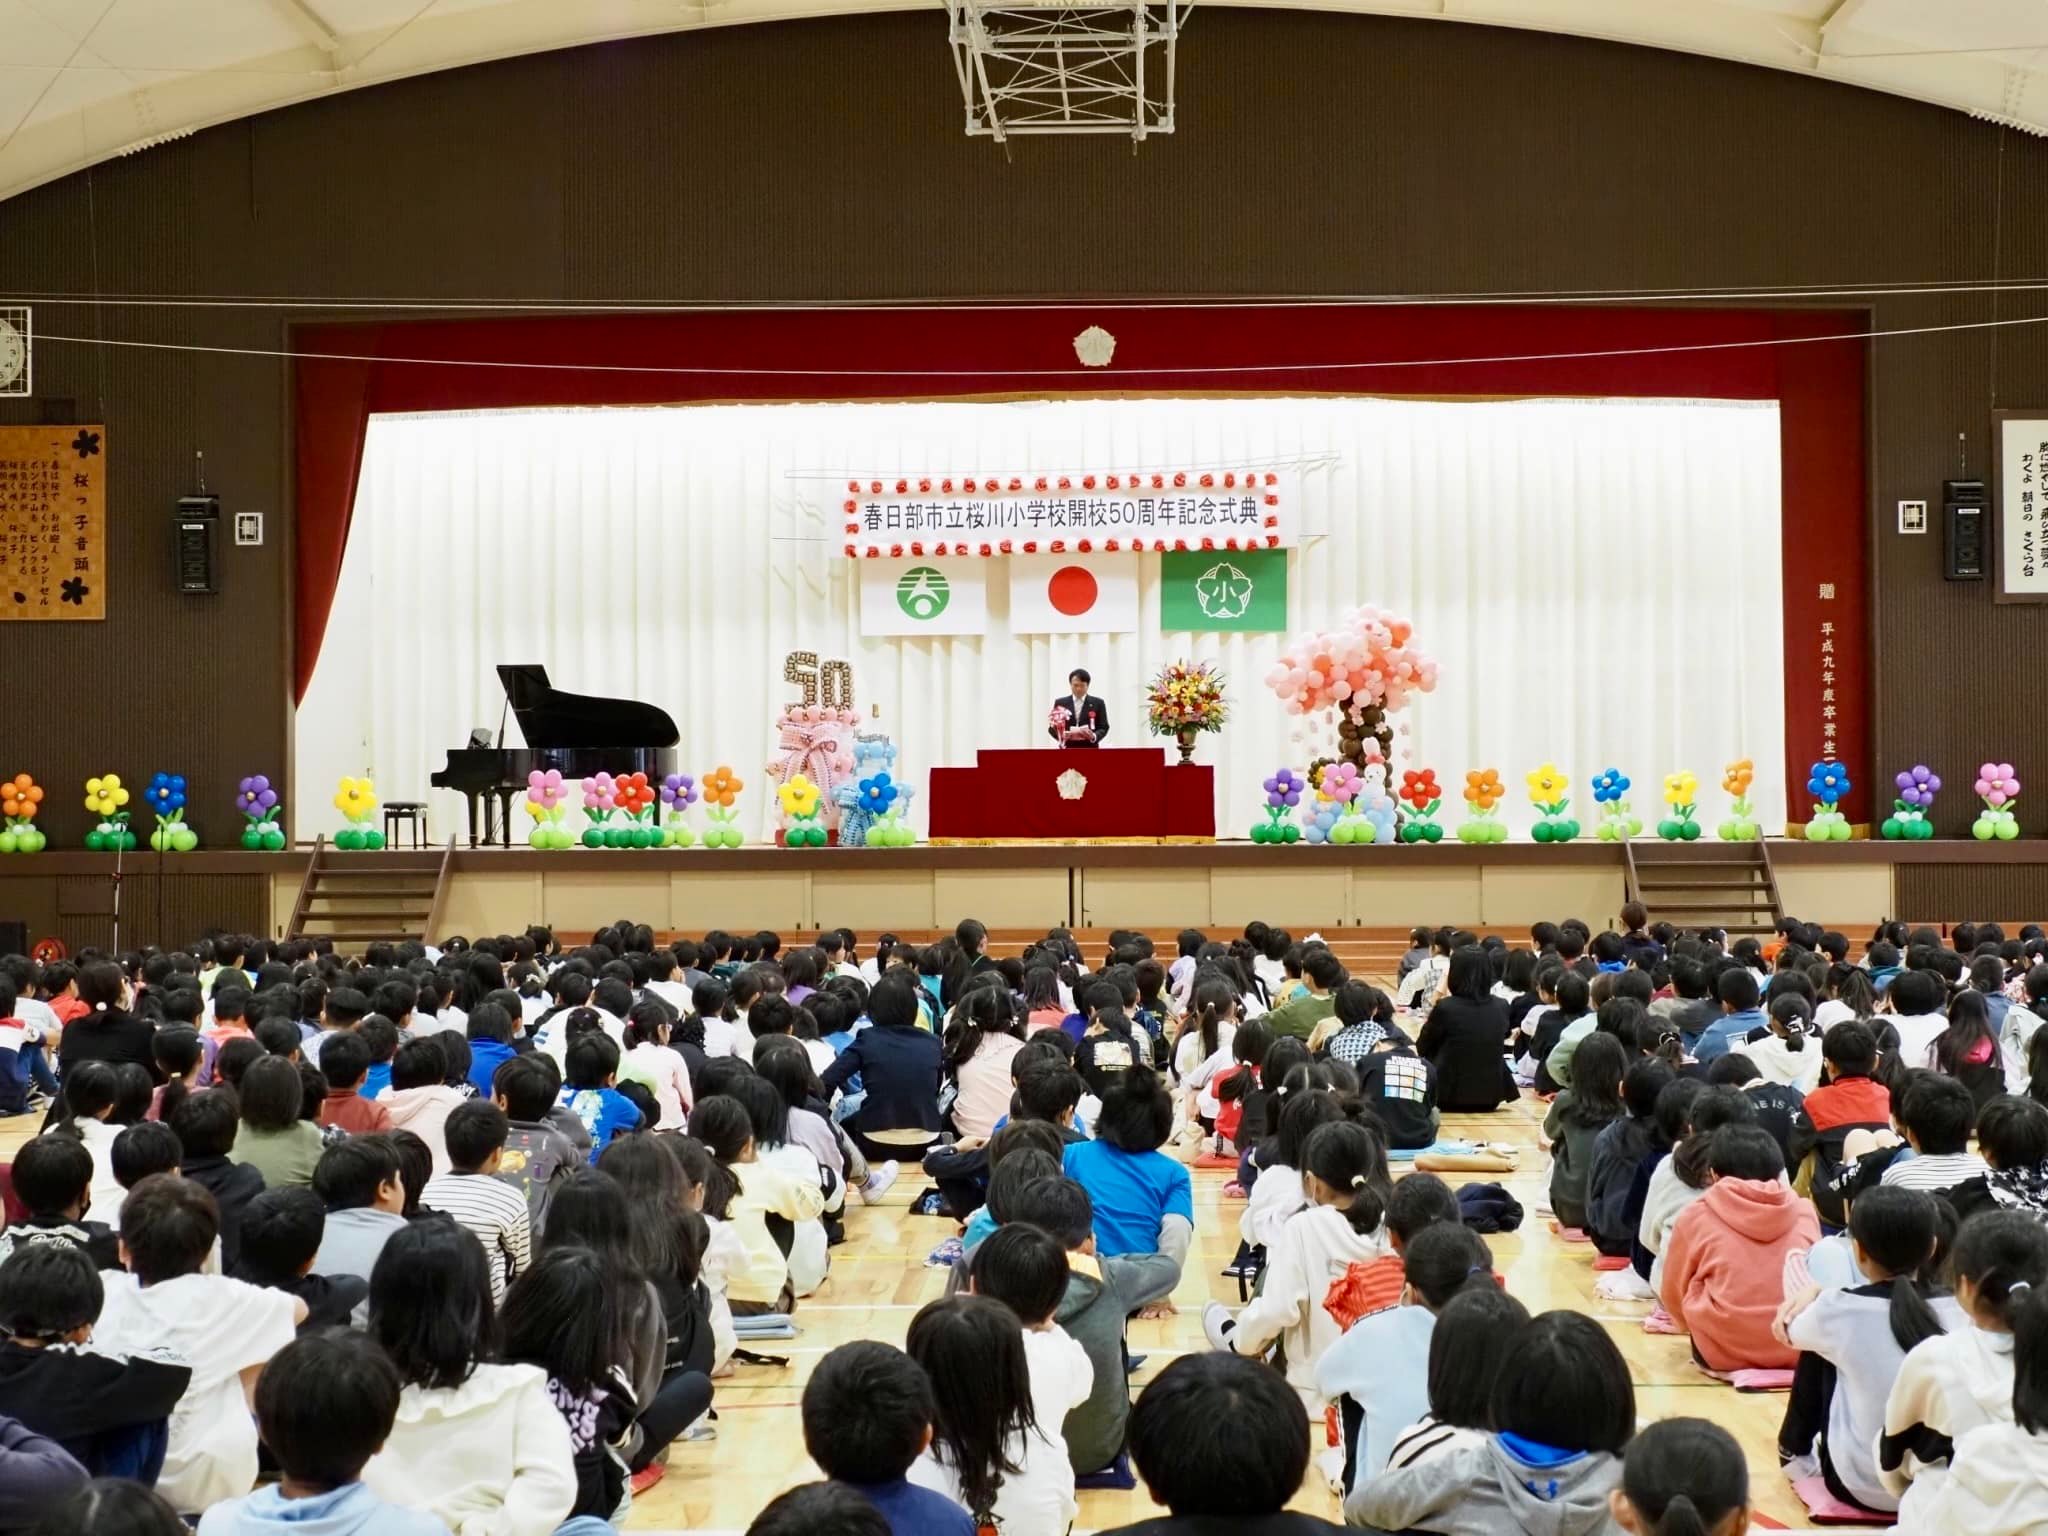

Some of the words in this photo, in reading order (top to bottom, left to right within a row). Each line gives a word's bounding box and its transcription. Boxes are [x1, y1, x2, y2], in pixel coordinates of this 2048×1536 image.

[2021, 453, 2034, 484] わくよ
[73, 472, 89, 572] 桜っ子音頭
[863, 496, 1259, 531] 春日部市立桜川小学校開校50周年記念式典
[2021, 491, 2034, 522] 朝日の
[2022, 530, 2035, 577] さくら台
[39, 554, 49, 606] ランドセル
[1819, 583, 1835, 600] 贈
